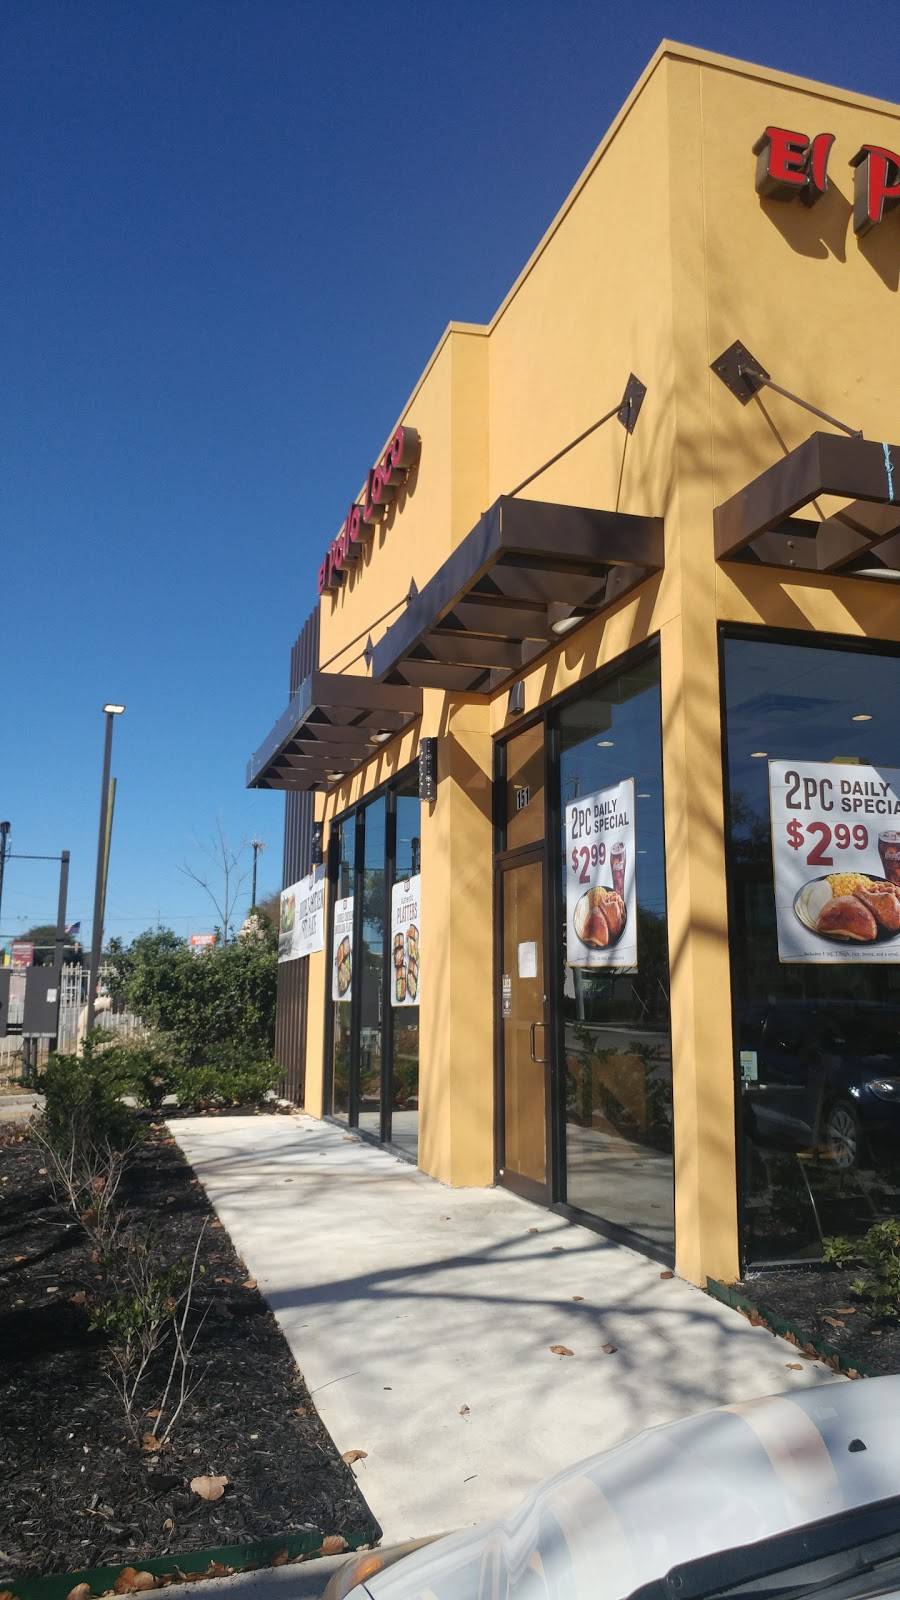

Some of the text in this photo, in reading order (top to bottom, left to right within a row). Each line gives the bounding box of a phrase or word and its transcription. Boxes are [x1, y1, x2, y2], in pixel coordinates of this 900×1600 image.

[761, 125, 836, 196] El
[784, 770, 891, 812] 2PC DAILY
[571, 798, 617, 840] 2PC DAILY
[594, 812, 630, 834] SPECIAL
